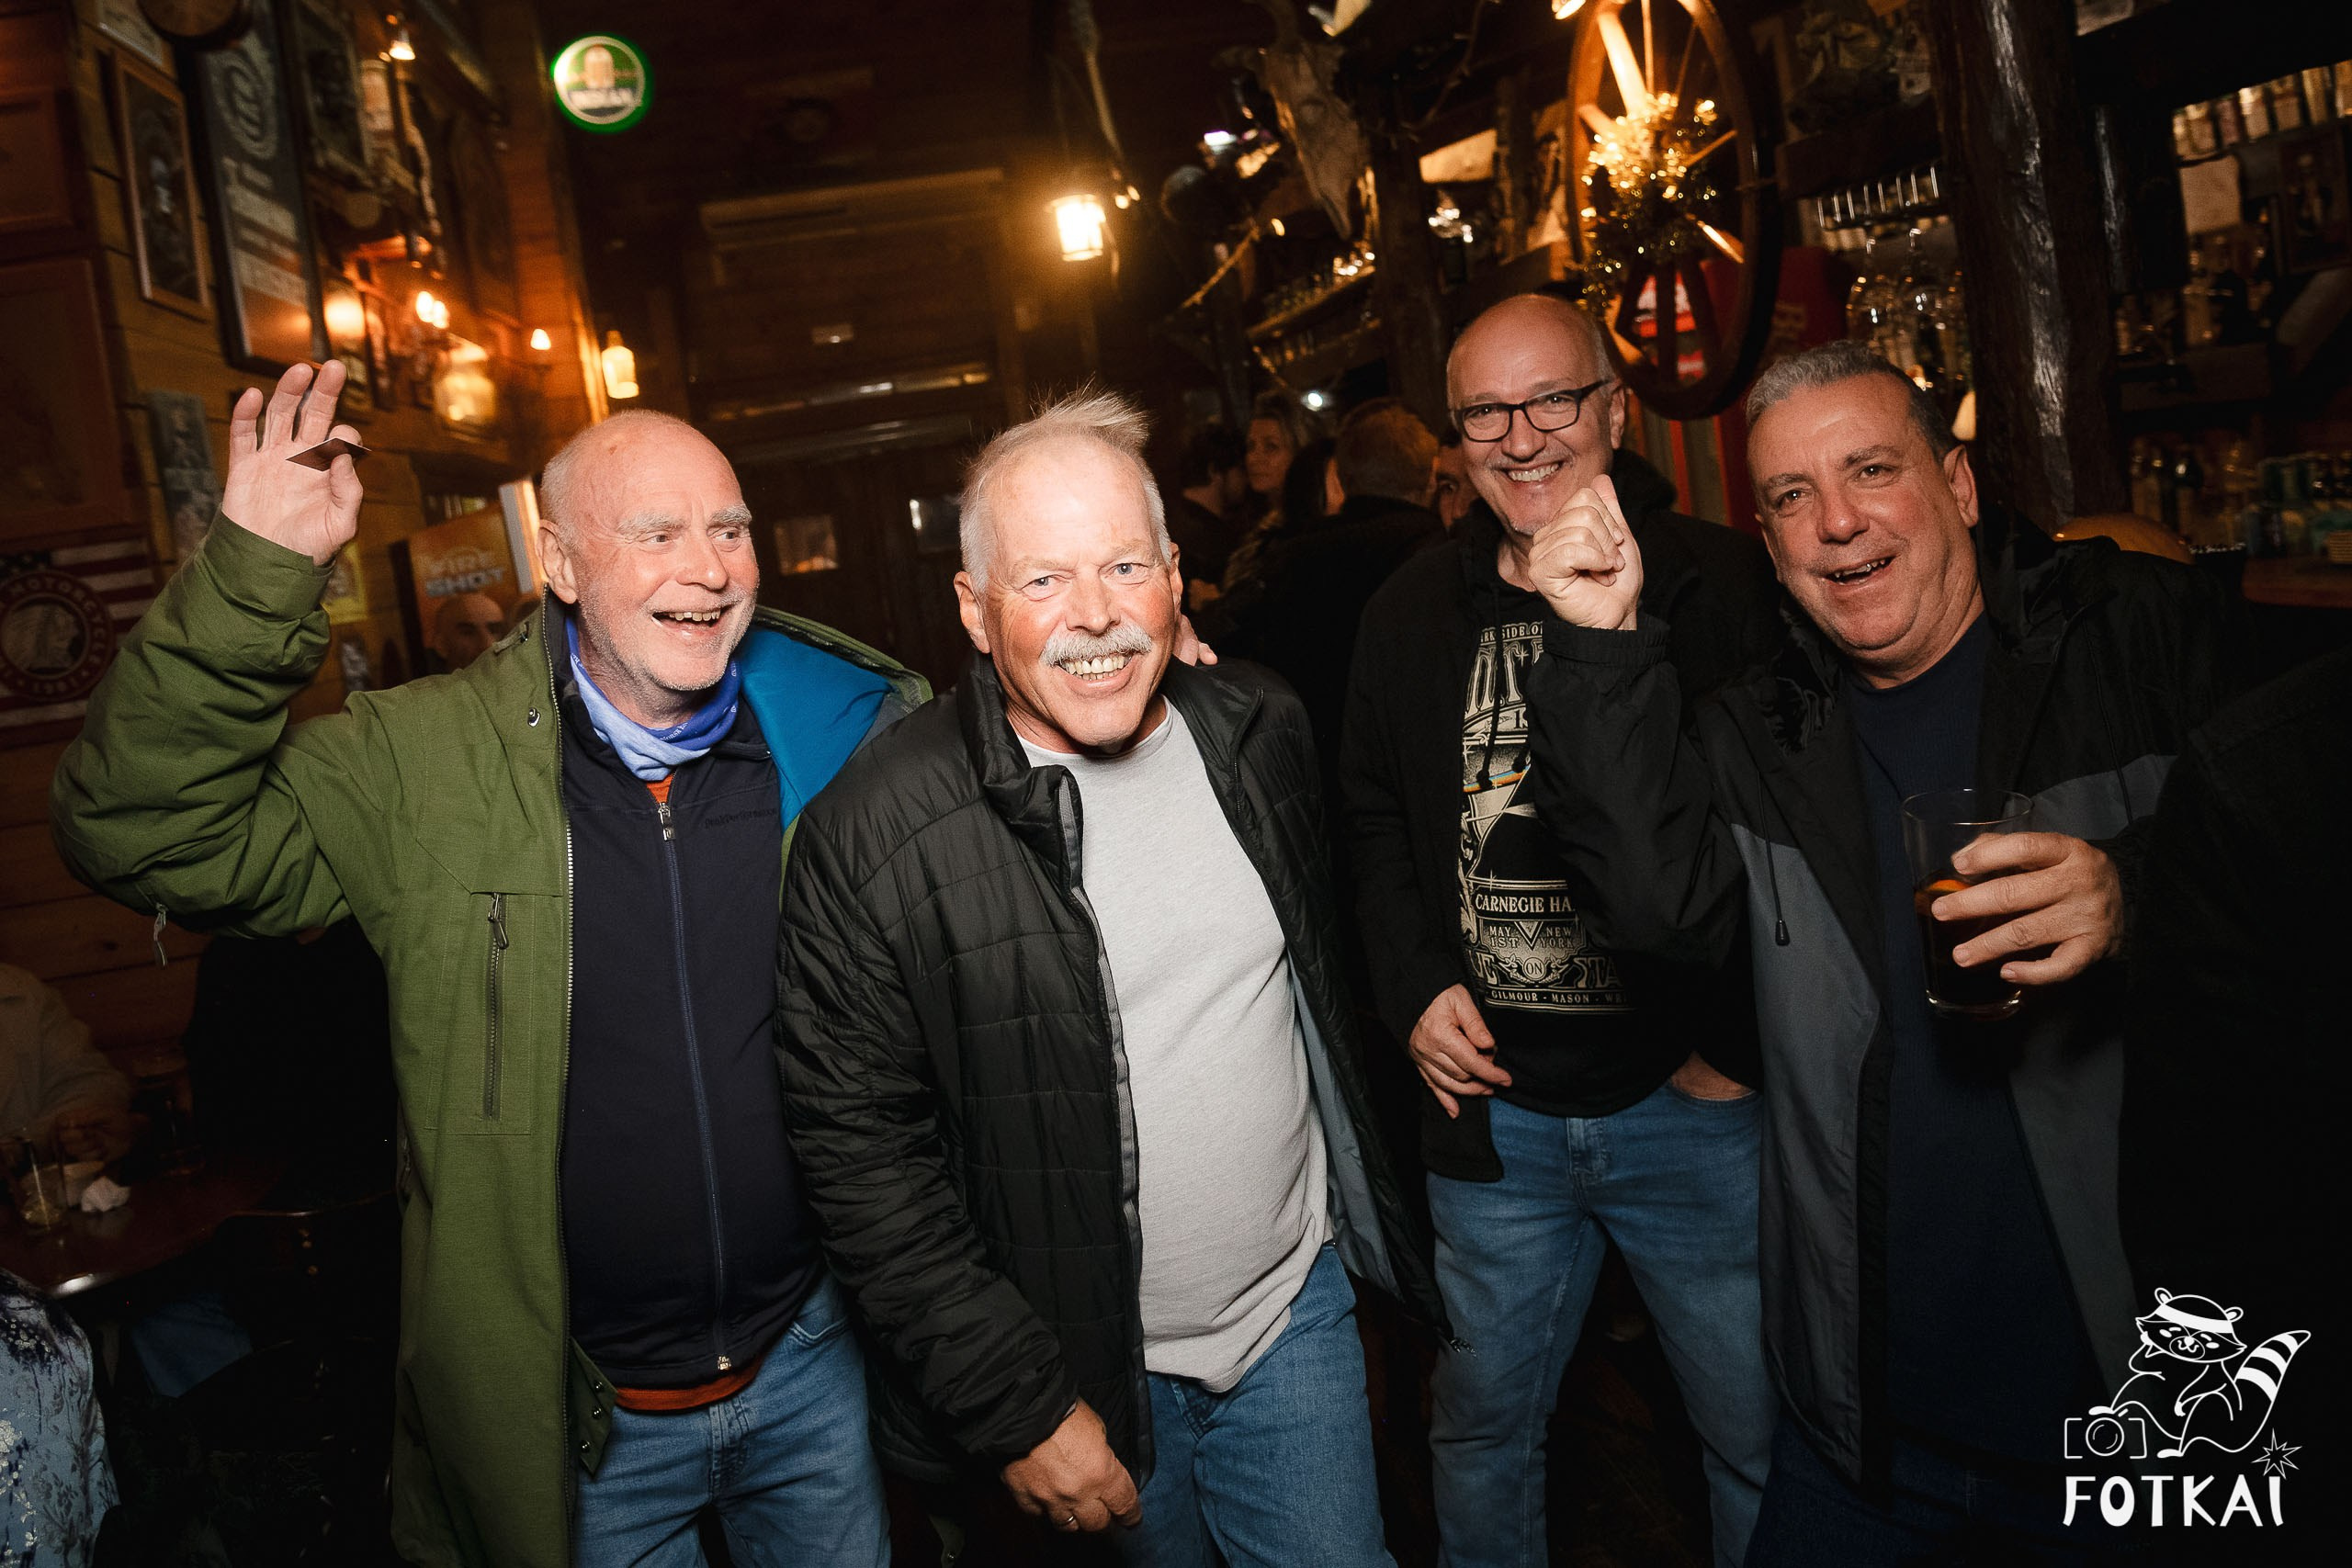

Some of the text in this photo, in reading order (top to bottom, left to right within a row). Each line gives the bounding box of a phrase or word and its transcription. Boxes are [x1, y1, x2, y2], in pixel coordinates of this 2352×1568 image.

[1475, 893, 1575, 913] CARNEGIE HA
[1488, 925, 1511, 937] MAY
[1545, 926, 1572, 938] NEW
[1539, 937, 1574, 949] YORK
[1526, 961, 1543, 975] ON
[1491, 990, 1538, 1002] GILMOUR
[1551, 992, 1589, 1004] MASON
